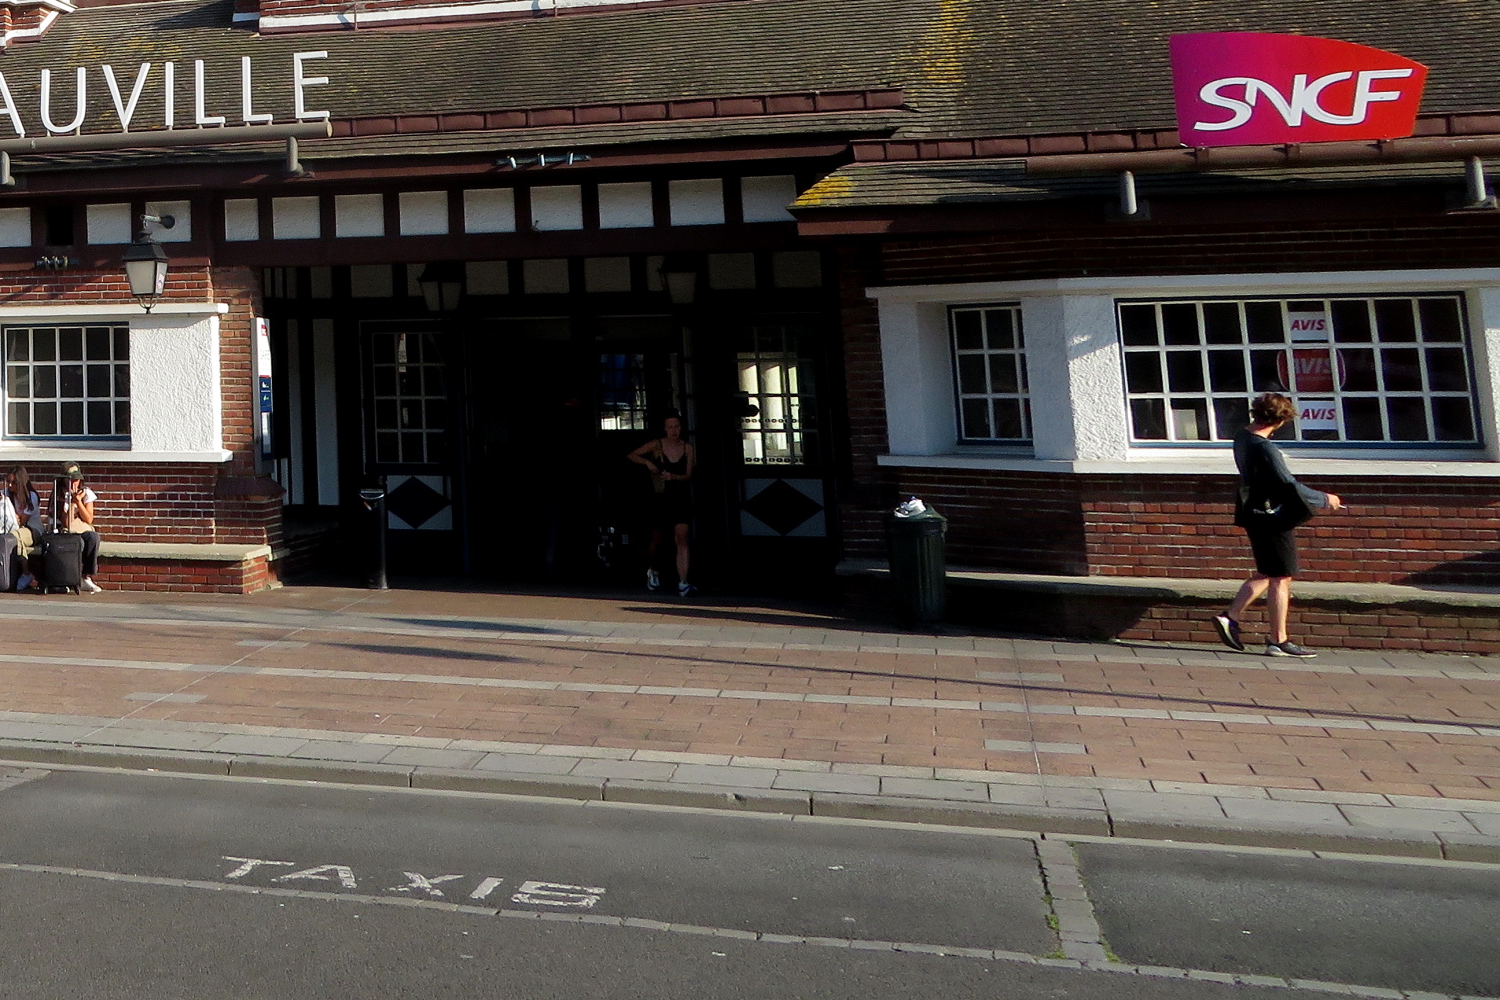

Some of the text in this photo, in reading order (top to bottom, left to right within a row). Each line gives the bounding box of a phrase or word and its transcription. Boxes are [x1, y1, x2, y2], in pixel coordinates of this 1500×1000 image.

[1193, 67, 1414, 132] SNCF
[1291, 319, 1326, 331] AVIS
[1301, 408, 1337, 420] AVIS
[221, 855, 607, 909] TAXIS
